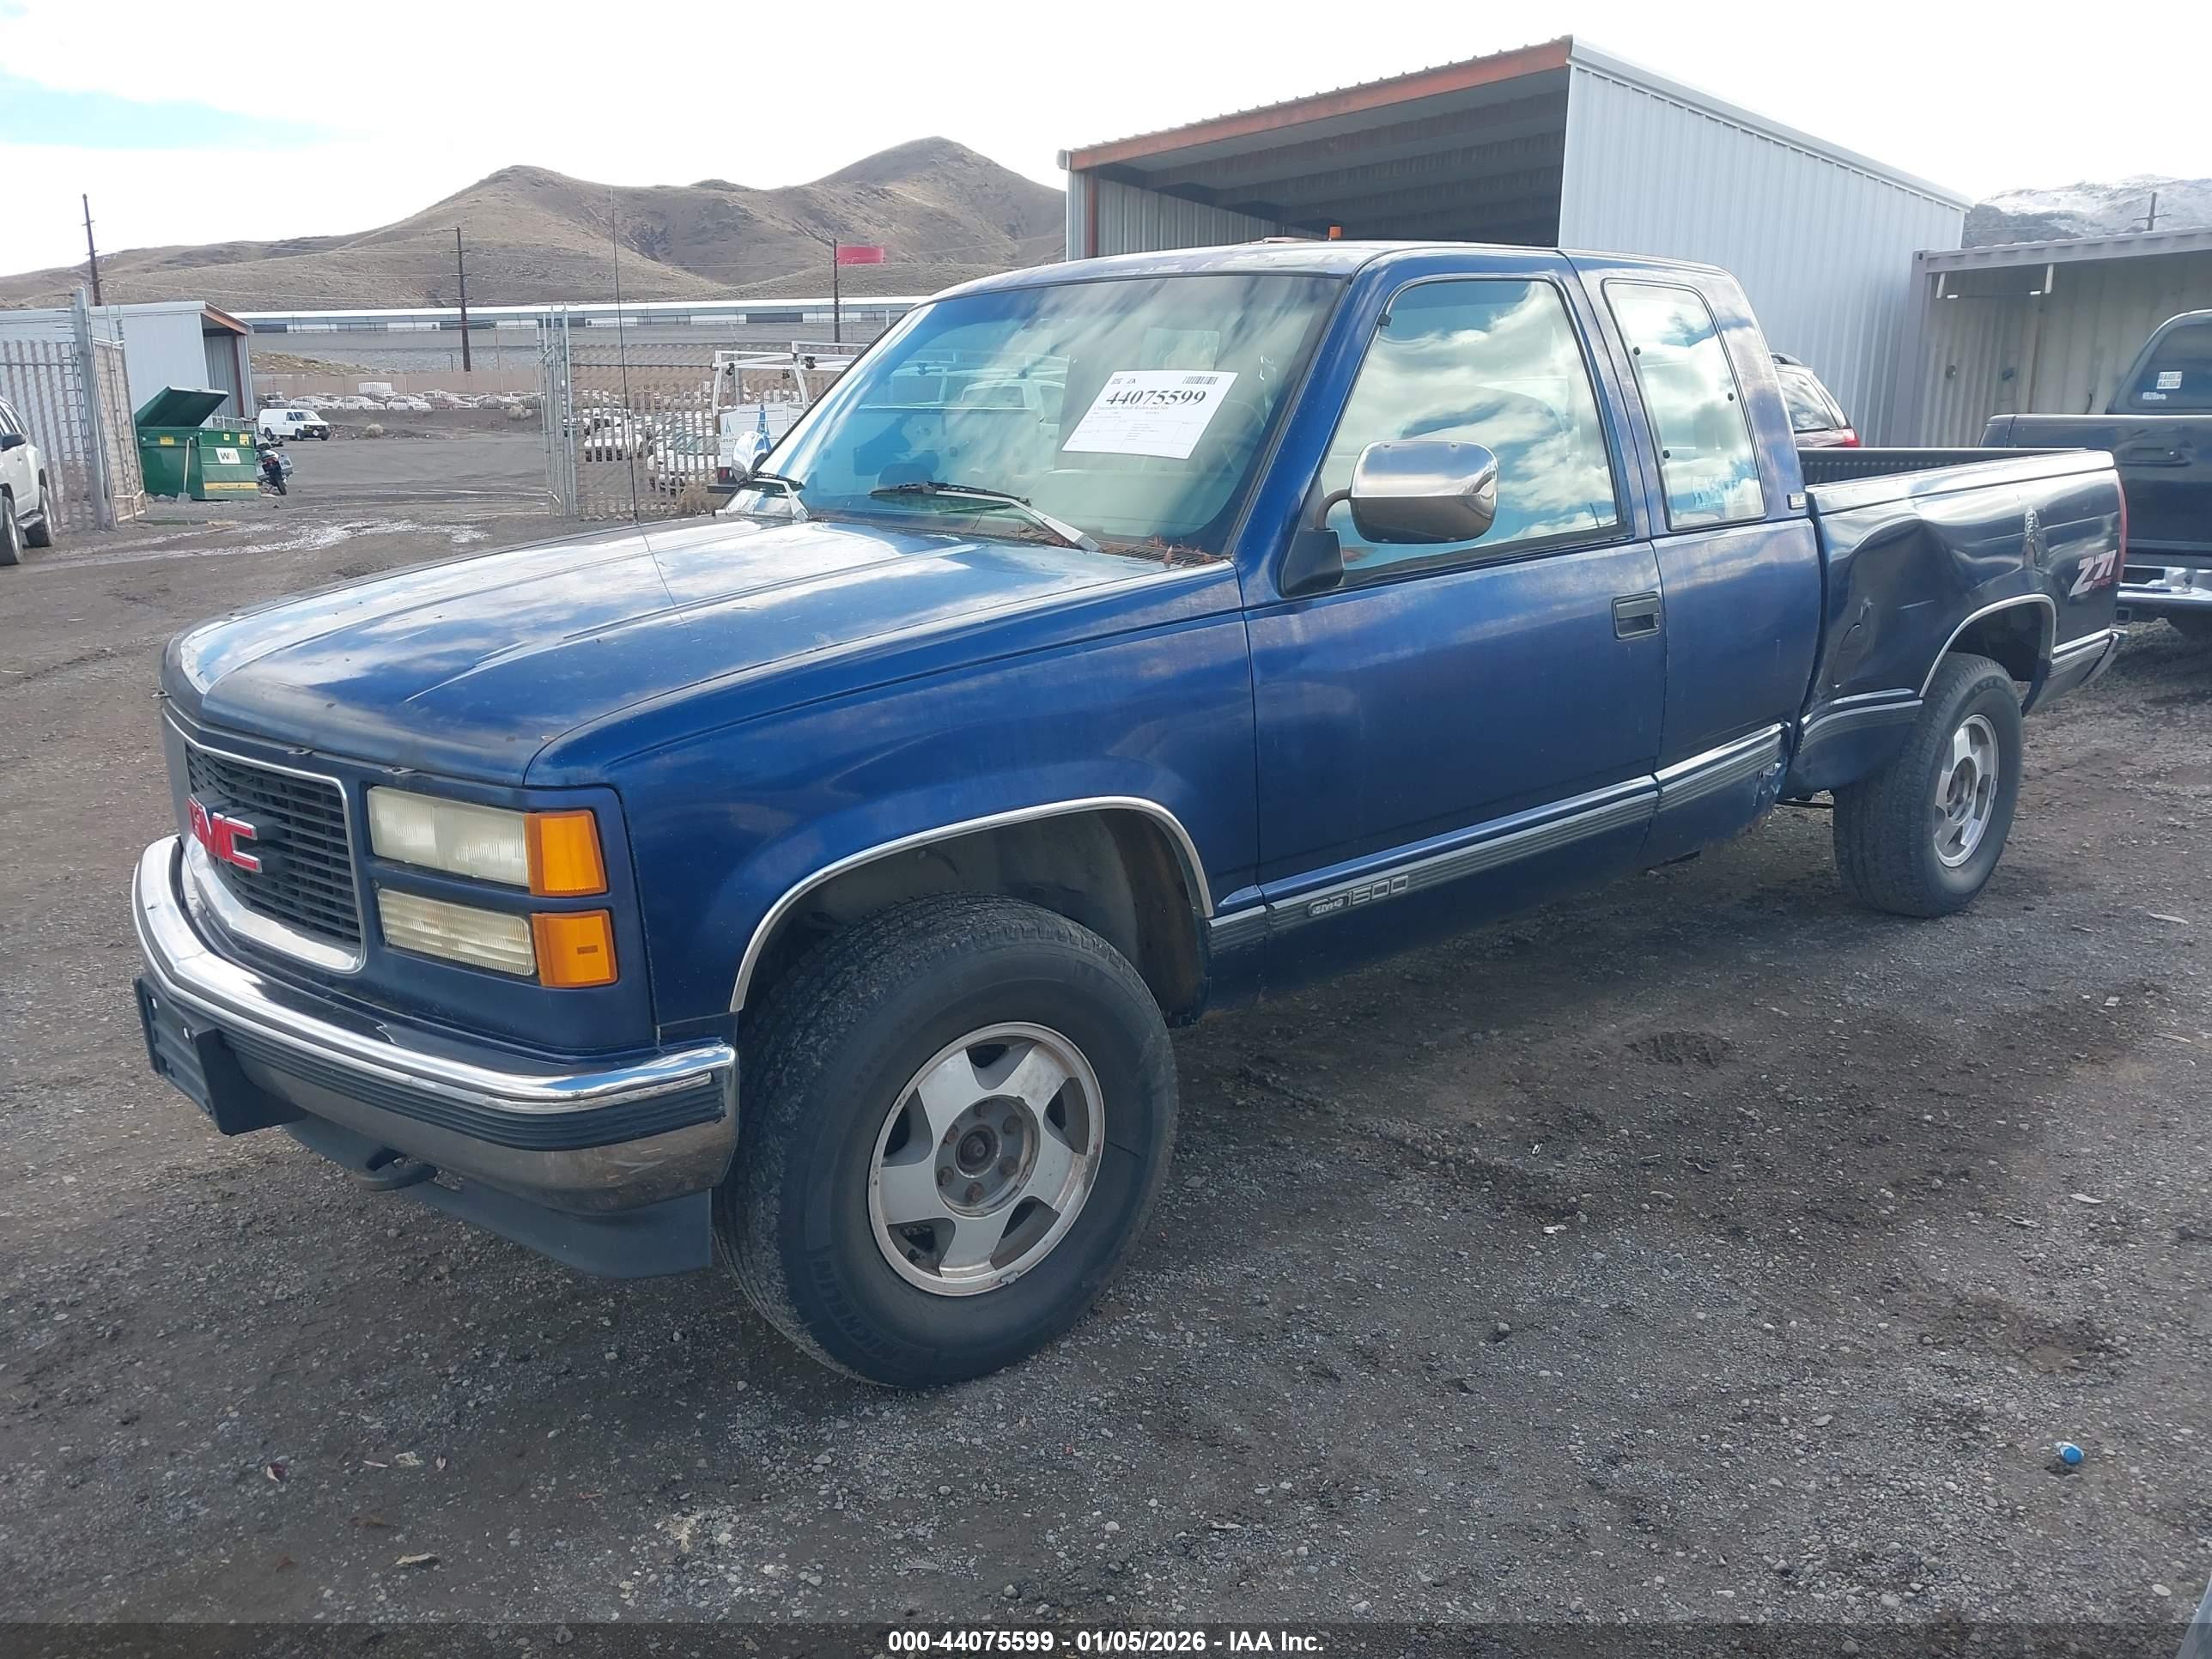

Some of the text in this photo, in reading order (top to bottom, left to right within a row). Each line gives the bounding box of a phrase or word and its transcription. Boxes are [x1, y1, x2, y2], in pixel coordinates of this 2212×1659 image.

[1106, 390, 1206, 405] 44075599
[2069, 550, 2118, 597] Z71
[1347, 875, 1409, 907] 1500
